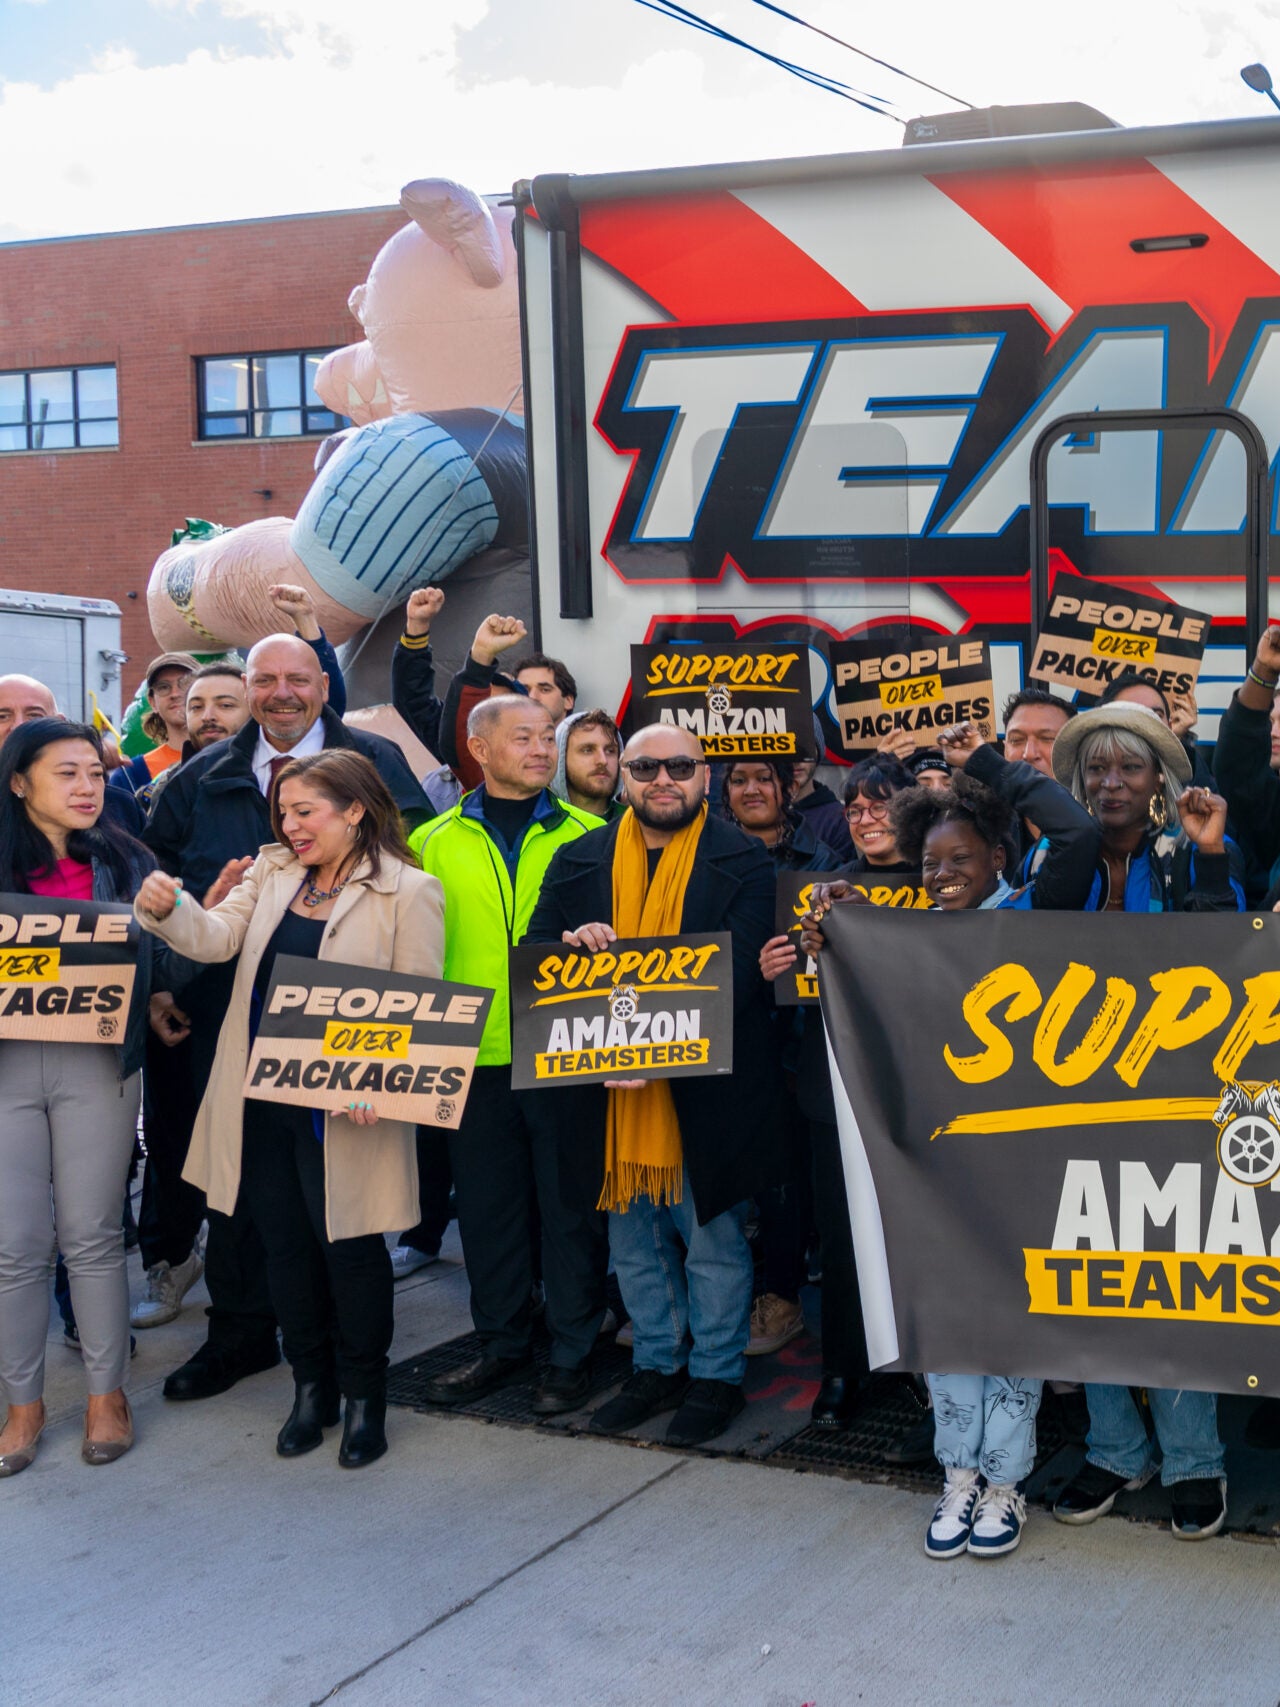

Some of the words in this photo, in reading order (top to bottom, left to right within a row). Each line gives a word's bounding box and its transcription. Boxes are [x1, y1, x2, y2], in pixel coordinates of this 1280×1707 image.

[1050, 595, 1206, 642] PEOPLE
[836, 640, 983, 687] PEOPLE
[1097, 635, 1151, 658] OVER
[646, 653, 799, 684] SUPPORT
[886, 680, 936, 704] OVER
[659, 707, 788, 736] AMAZON
[845, 697, 990, 741] PACKAGES
[700, 736, 791, 753] MSTERS
[533, 943, 721, 991] SUPPORT
[268, 984, 485, 1024] PEOPLE
[330, 1028, 403, 1052] OVER
[546, 1008, 701, 1054] AMAZON
[250, 1057, 467, 1096] PACKAGES
[544, 1042, 703, 1075] TEAMSTERS
